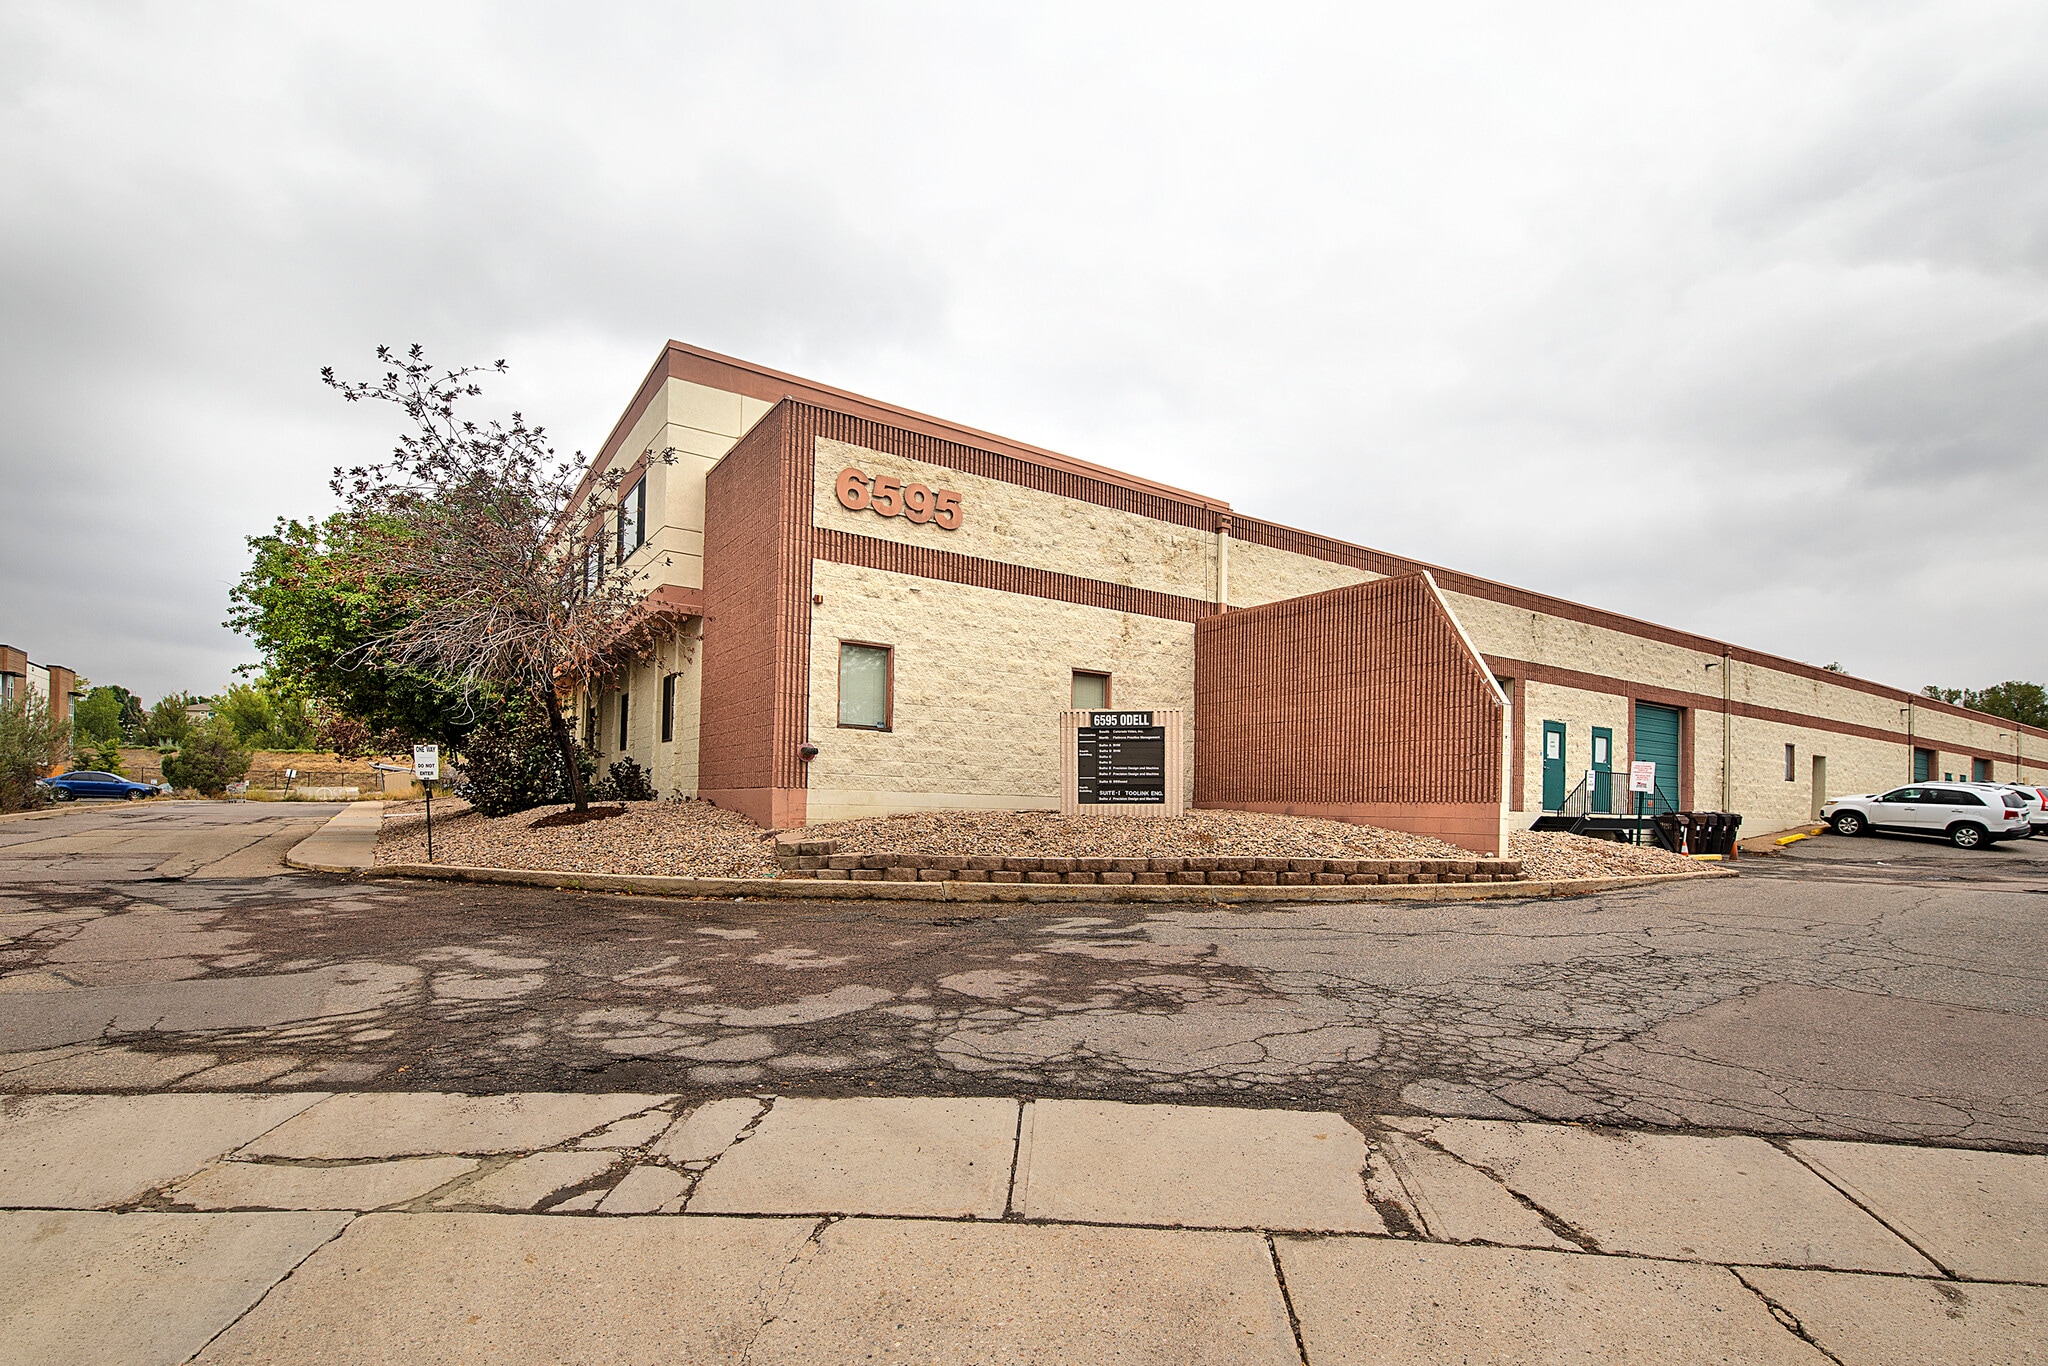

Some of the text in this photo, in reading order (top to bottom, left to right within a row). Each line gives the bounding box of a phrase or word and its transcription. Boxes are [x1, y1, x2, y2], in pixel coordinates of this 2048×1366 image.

[836, 467, 963, 530] 6595
[1094, 714, 1149, 726] 6595 ODELL
